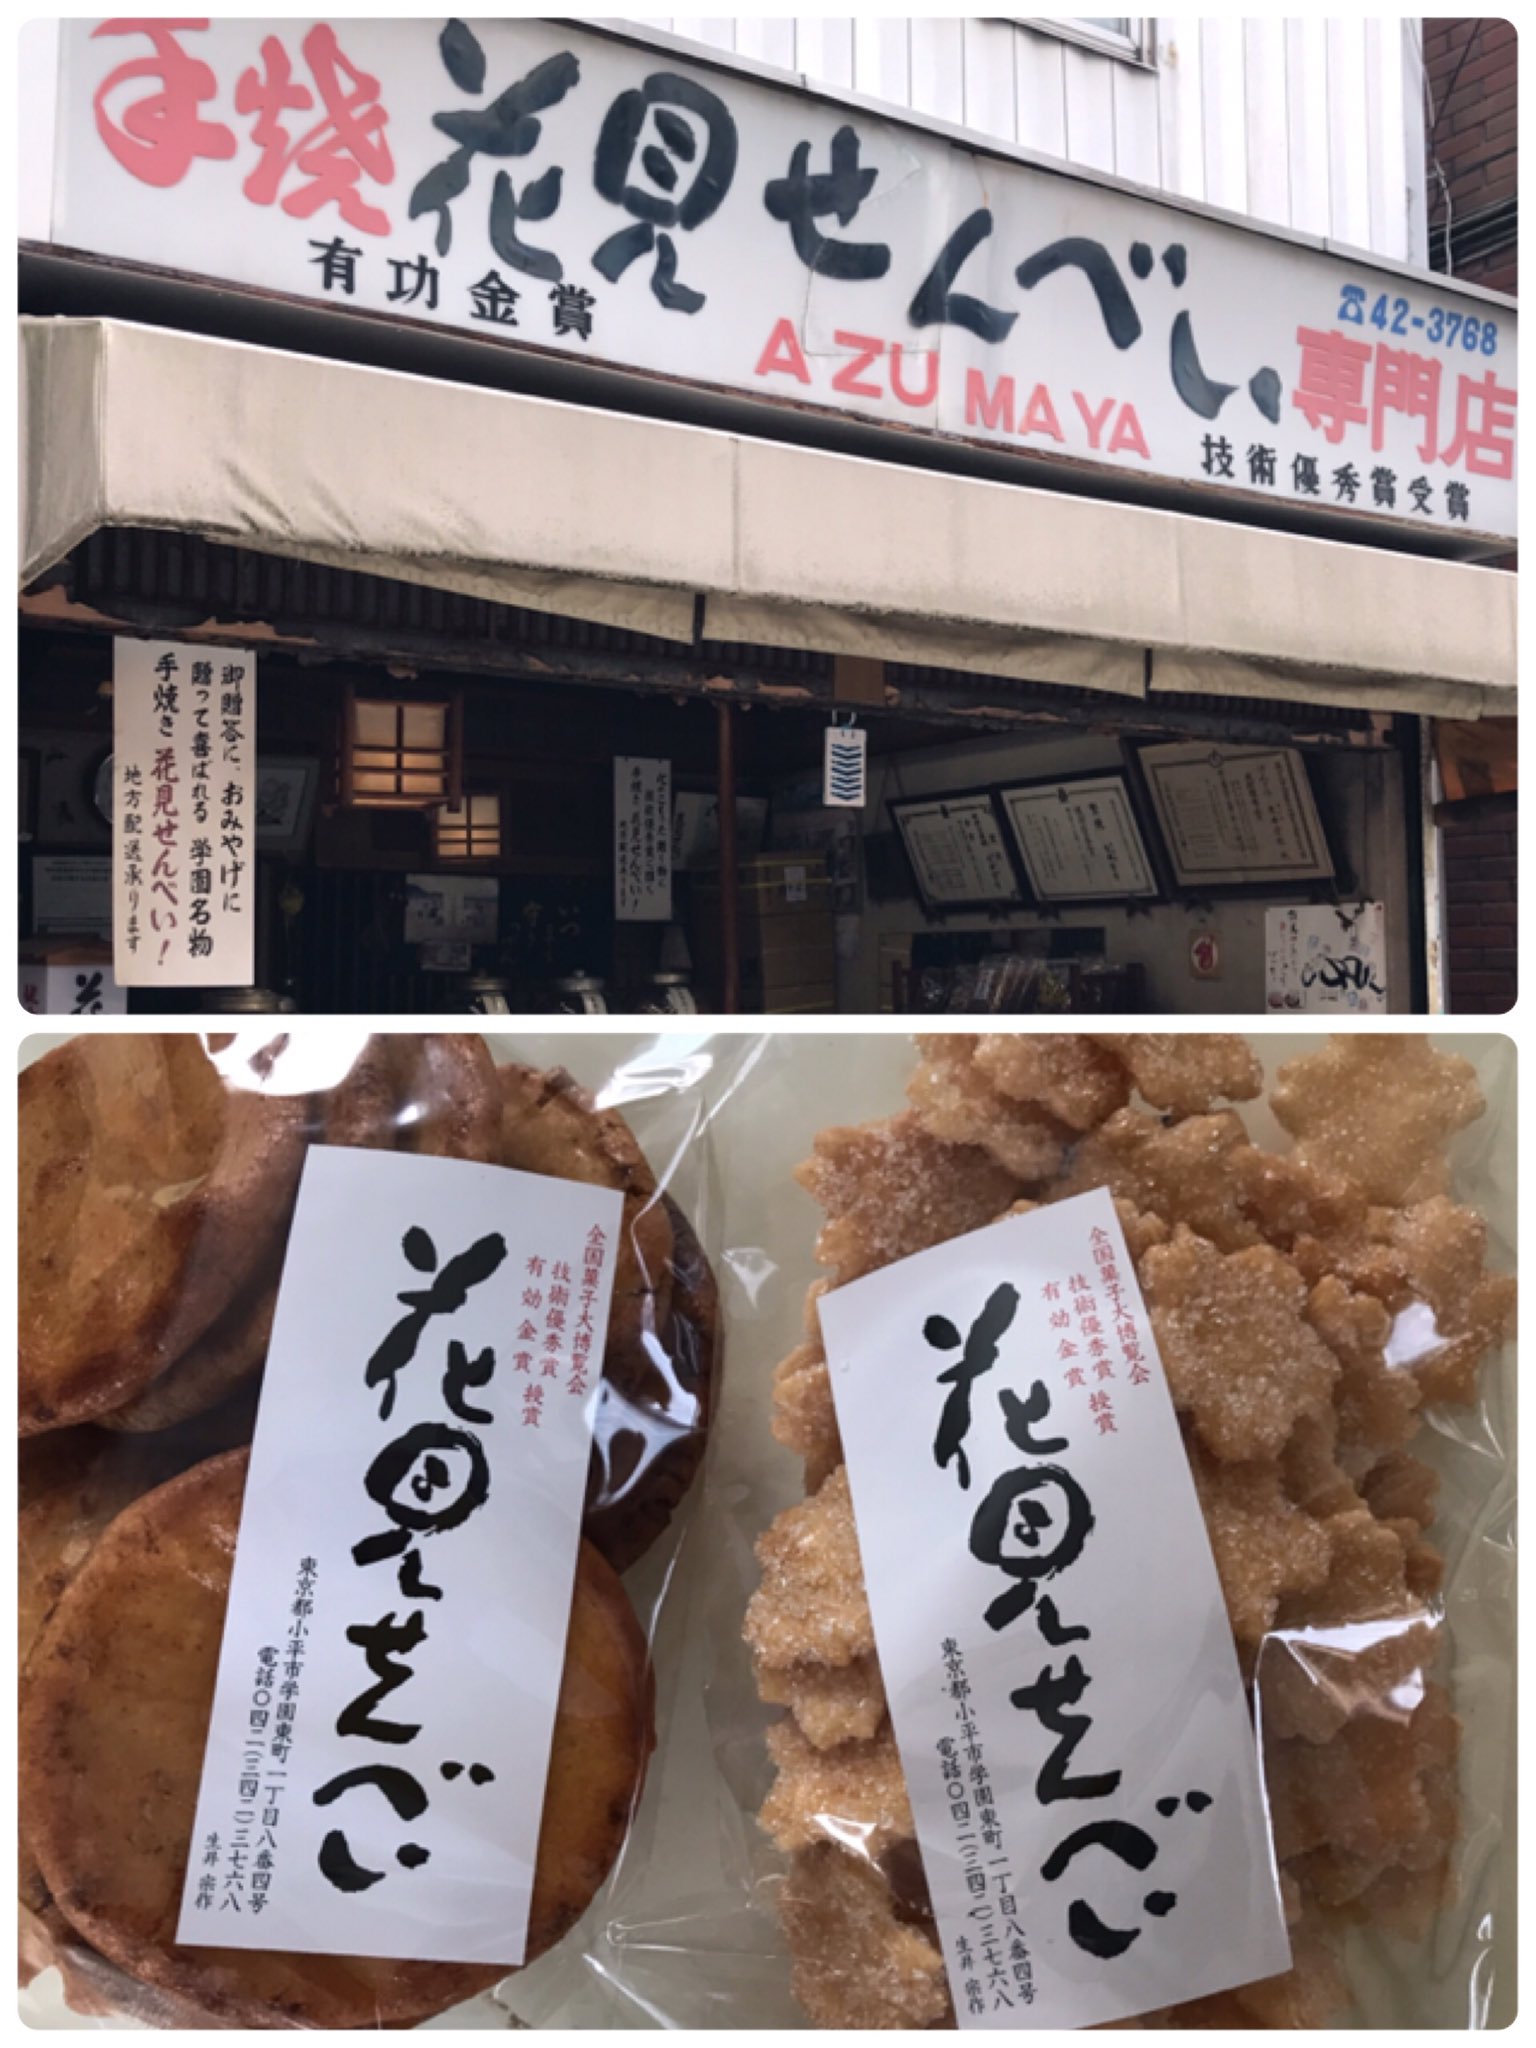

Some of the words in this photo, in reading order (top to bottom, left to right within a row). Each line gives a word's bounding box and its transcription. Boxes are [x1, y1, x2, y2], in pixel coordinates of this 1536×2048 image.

[310, 238, 597, 341] 有功金賞
[409, 18, 1280, 424] 花見せんべい
[1371, 296, 1498, 357] 42-3768
[1202, 435, 1470, 521] 技術優秀賞受賞
[1293, 327, 1517, 480] 専門店
[512, 1255, 548, 1374] 有効金賞
[566, 1223, 607, 1397] 全国菓子大博覧会
[1041, 1281, 1088, 1391] 有効金賞
[1089, 1226, 1151, 1386] 全国菓子大博覧会
[313, 1226, 508, 1892] 花見せんべい
[923, 1282, 1213, 1960] 花見せんべい
